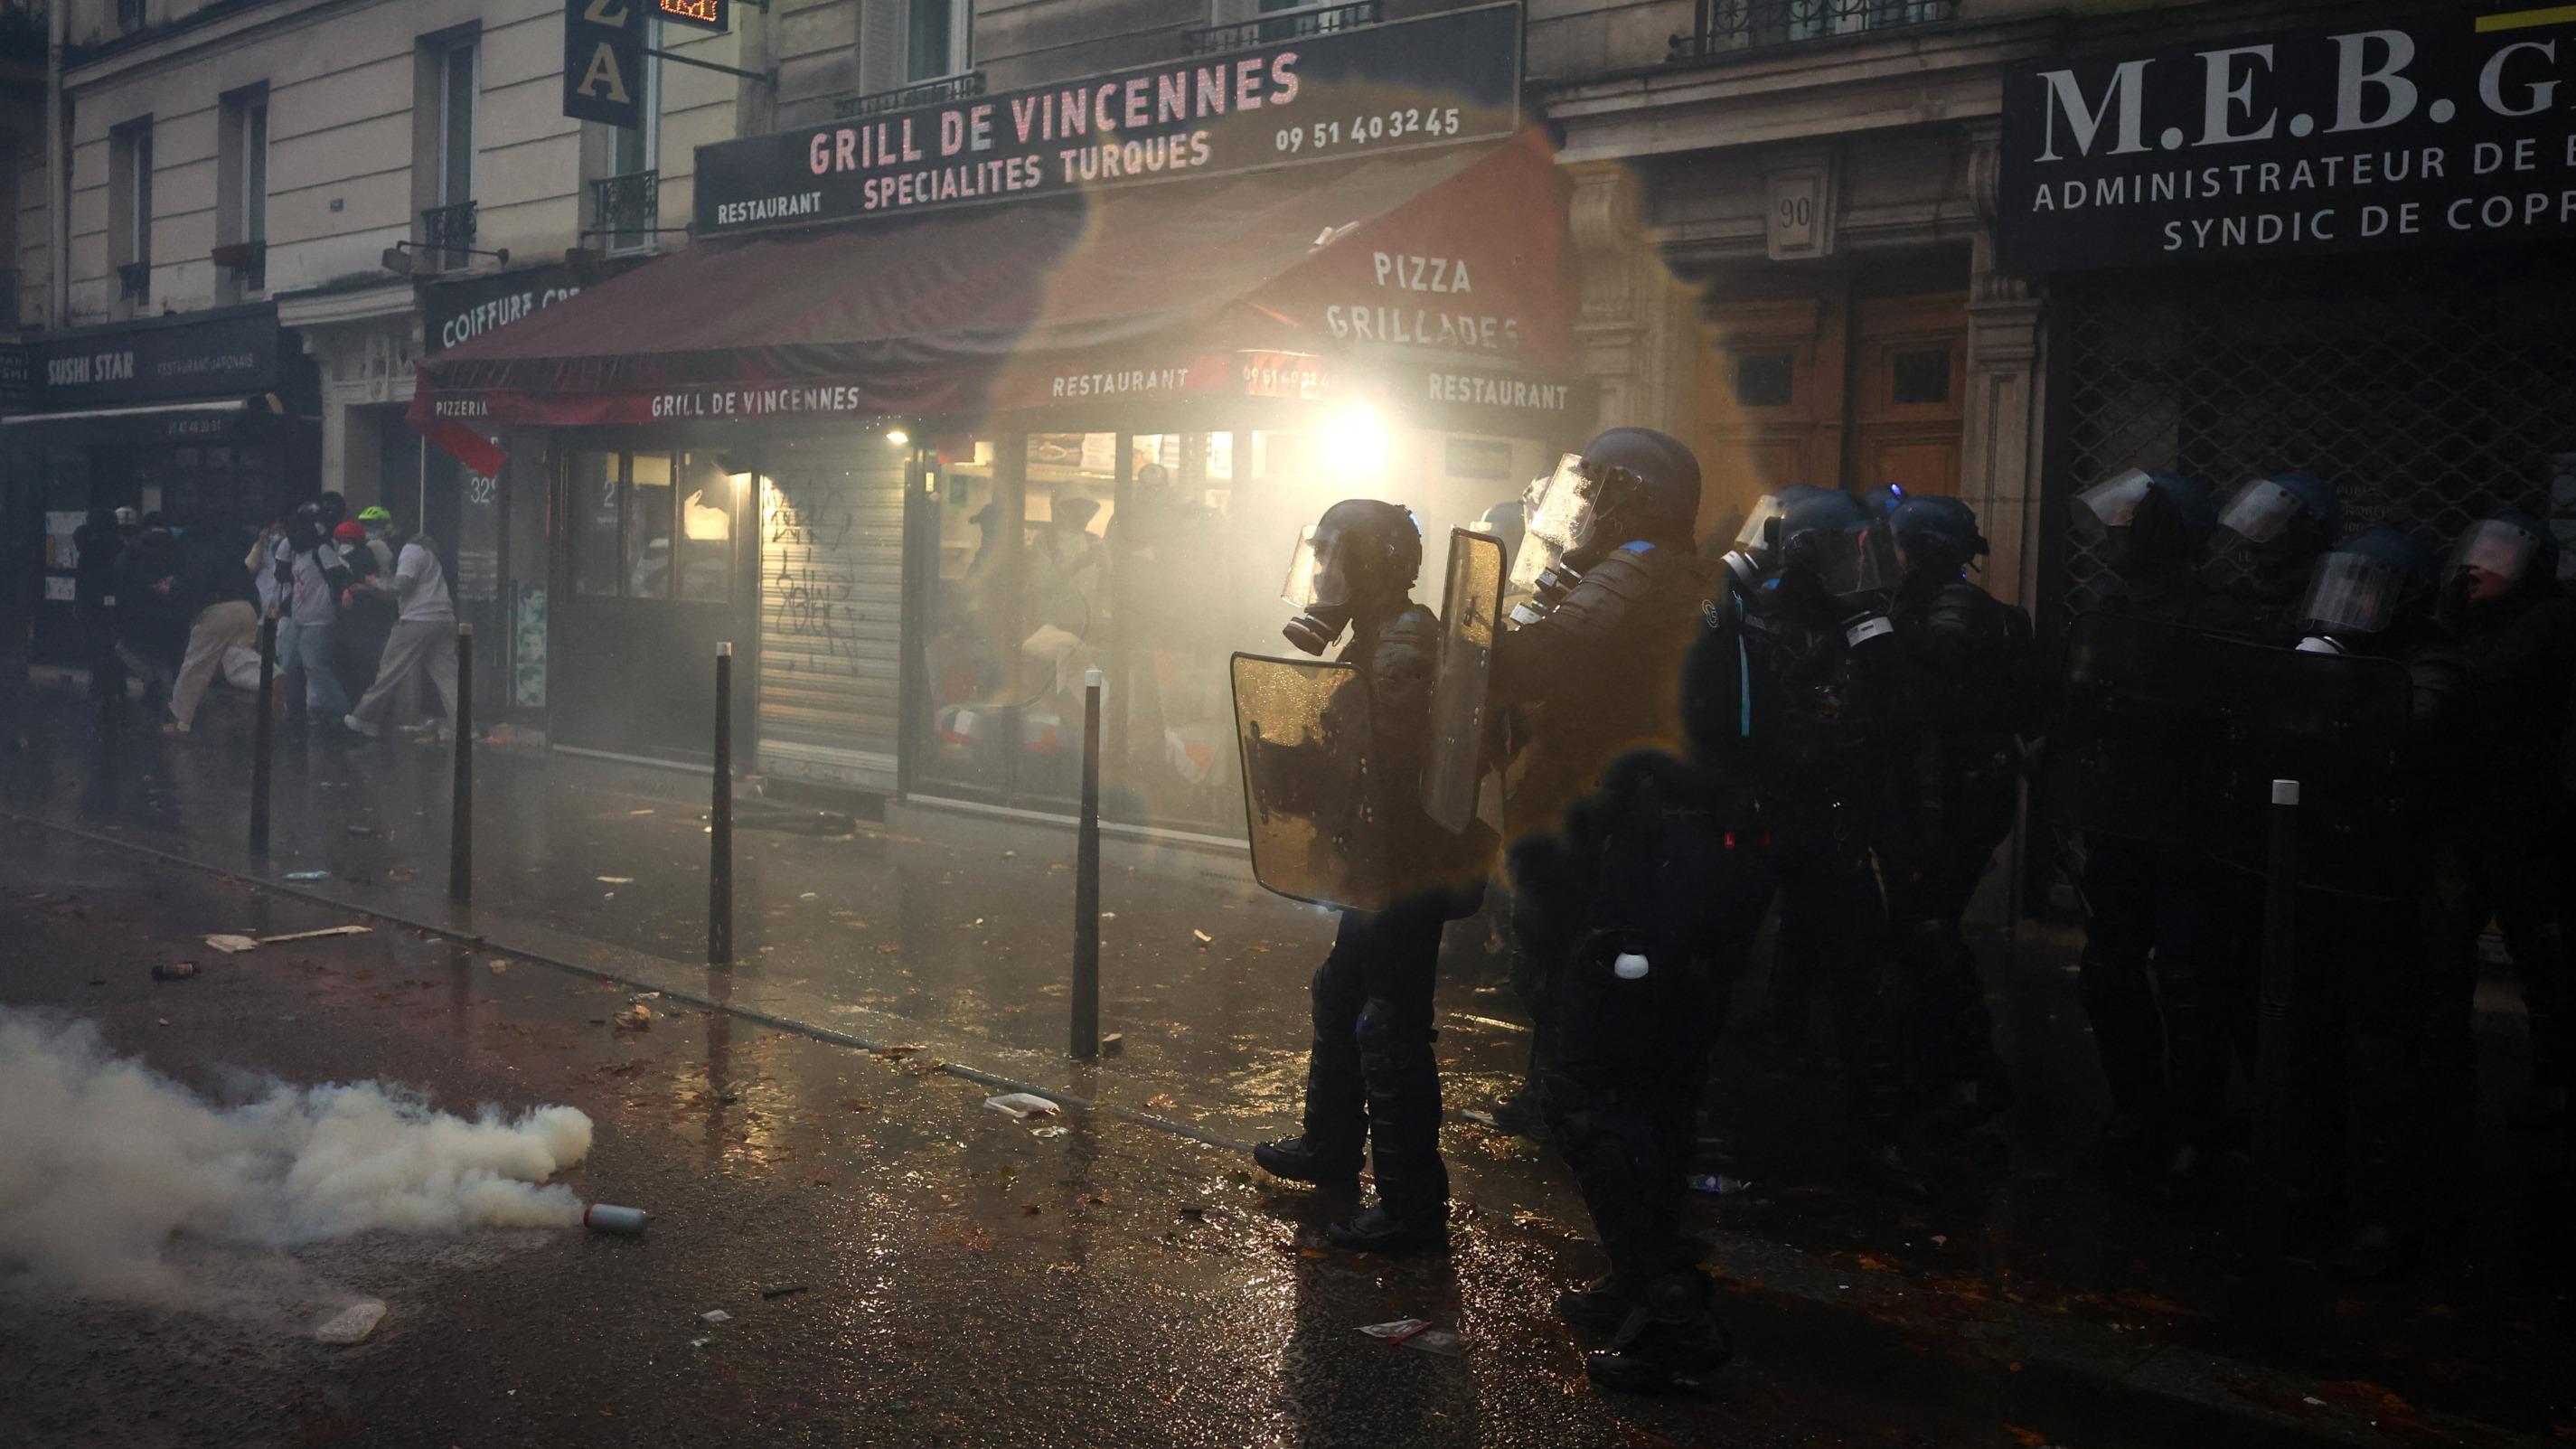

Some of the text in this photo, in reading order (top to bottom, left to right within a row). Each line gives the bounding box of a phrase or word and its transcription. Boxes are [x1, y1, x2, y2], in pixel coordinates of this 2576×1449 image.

[809, 52, 1300, 175] GRILL DE VINCENNES
[2034, 29, 2576, 163] M.E.B.G
[1275, 127, 1302, 152] 09
[1313, 121, 1340, 148] 51
[1350, 115, 1383, 144] 40
[863, 129, 1212, 211] SPECIALITES TURQUES
[2032, 146, 2445, 212] ADMINISTRATEUR
[2473, 138, 2536, 174] DE
[718, 191, 822, 225] RESTAURANT
[1782, 197, 1810, 228] 90
[2163, 209, 2336, 251] SYNDIC
[2361, 202, 2421, 237] DE
[1373, 251, 1472, 294] PIZZA
[442, 291, 533, 349] COIFFURE
[1326, 306, 1519, 349] GRILLADES
[47, 352, 134, 386] SUSHI STAR
[1053, 369, 1189, 397] RESTAURANT
[436, 400, 488, 417] PIZZERIA
[652, 386, 860, 417] GRILL DE VINCENNES
[1428, 373, 1569, 411] RESTAURANT
